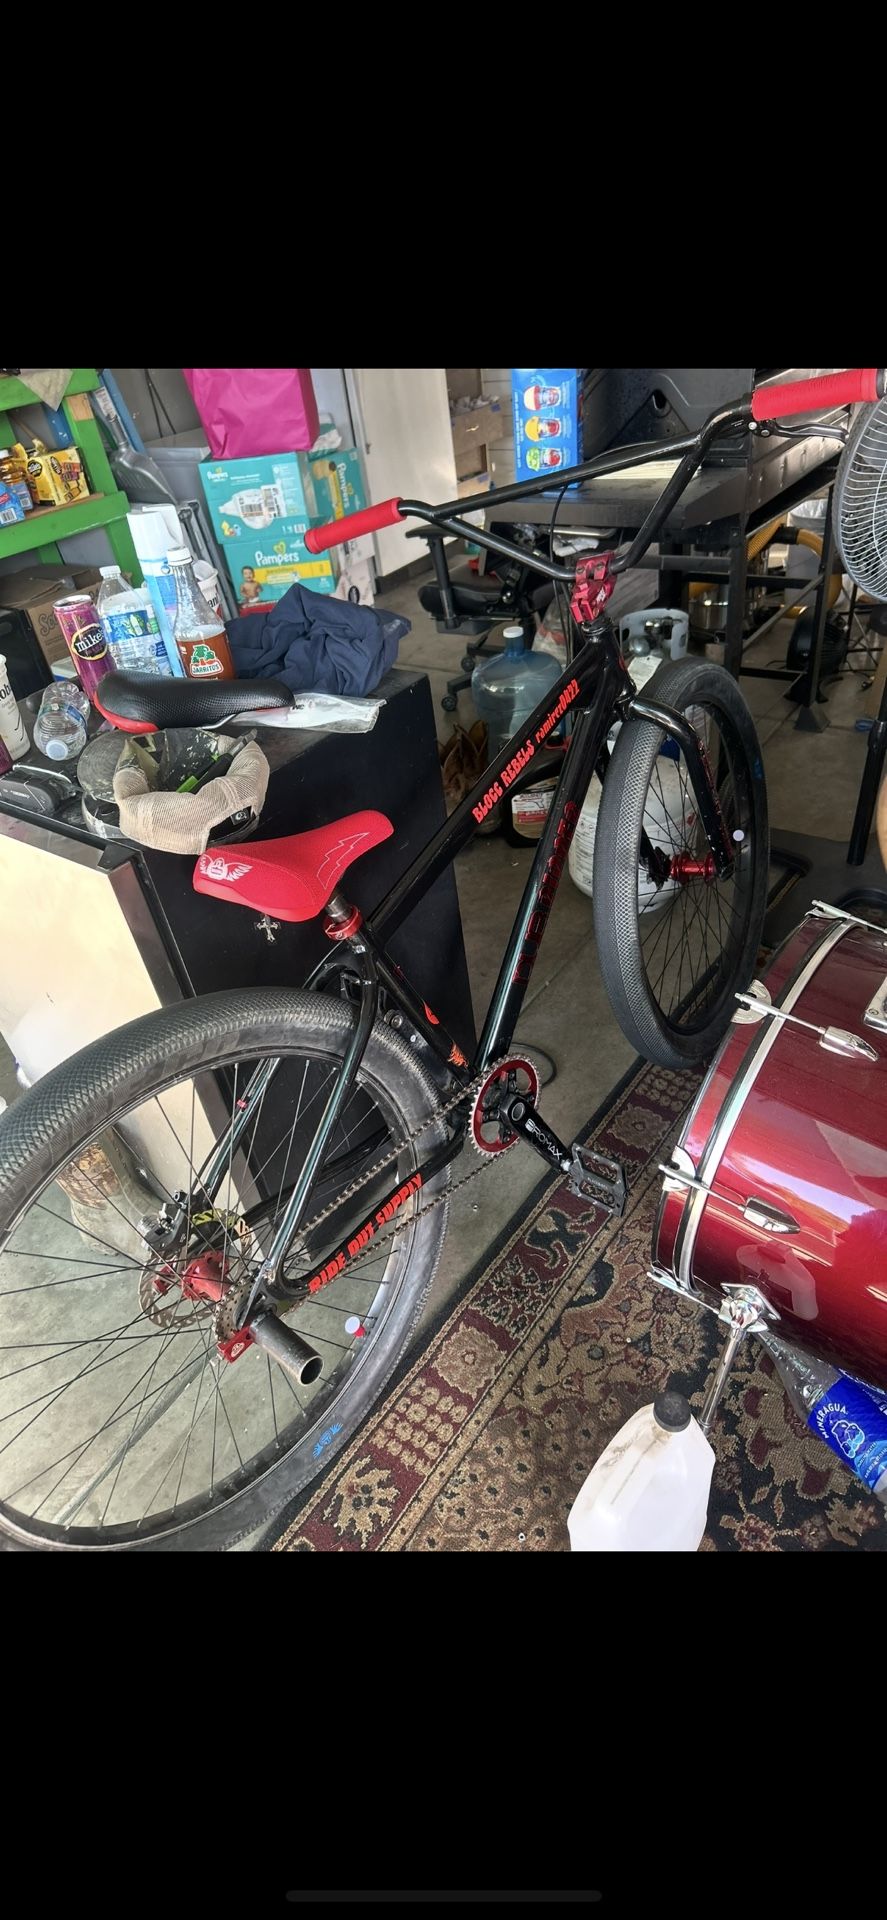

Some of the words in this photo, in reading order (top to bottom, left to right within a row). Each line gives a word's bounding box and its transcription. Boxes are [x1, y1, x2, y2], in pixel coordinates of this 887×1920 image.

[255, 550, 299, 567] Pampers
[192, 663, 220, 674] JARRITOS
[471, 781, 503, 823] BLOCC
[500, 740, 535, 787] REBELS
[308, 1251, 346, 1293] RIDE
[347, 1221, 375, 1258] OUT
[375, 1172, 422, 1228] SUPPLY
[815, 1403, 846, 1439] MINERAGUA
